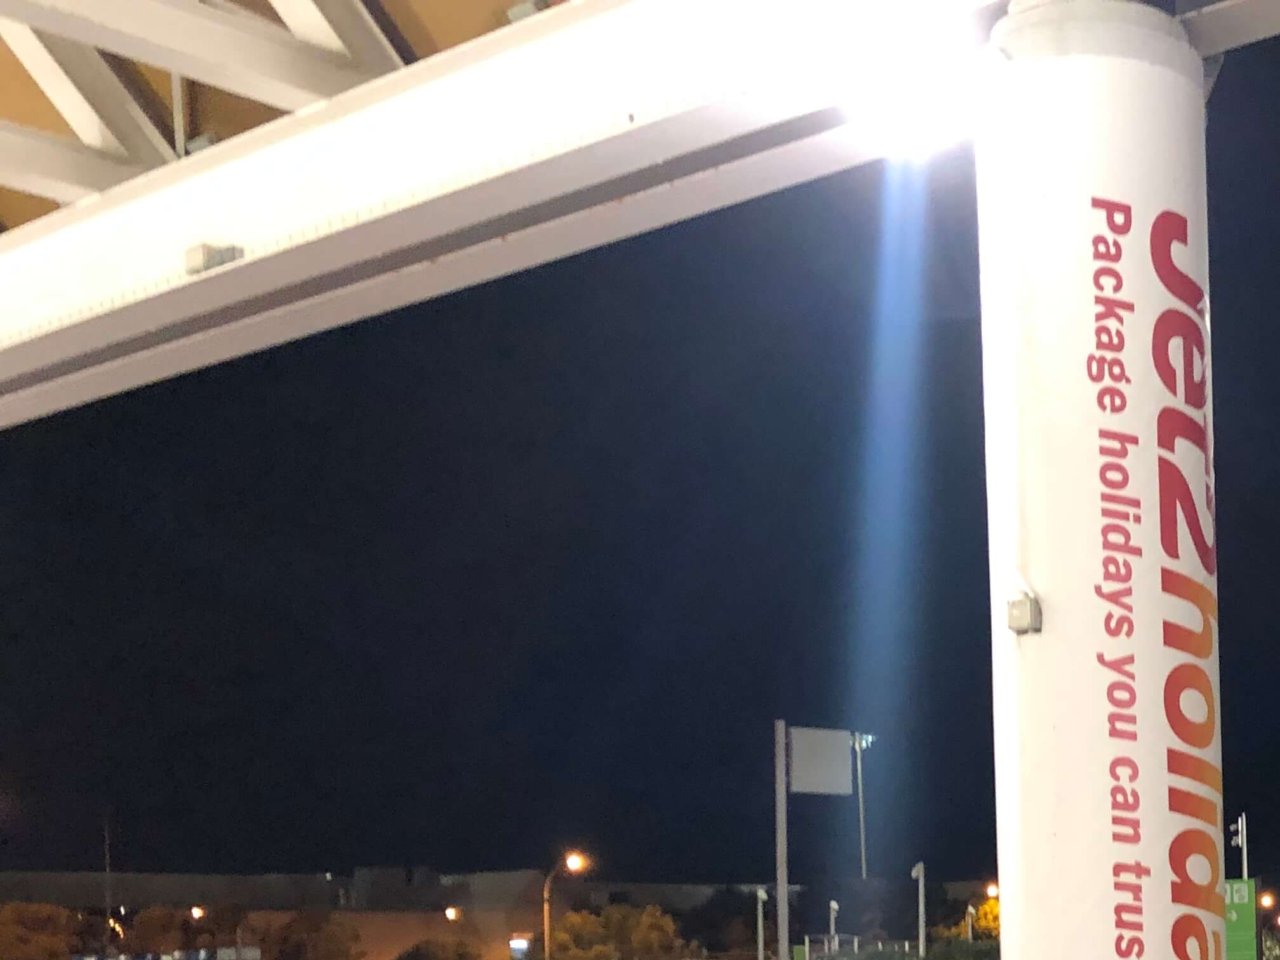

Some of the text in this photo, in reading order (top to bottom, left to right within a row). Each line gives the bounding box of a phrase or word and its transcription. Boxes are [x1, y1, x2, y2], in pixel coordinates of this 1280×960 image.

[1087, 196, 1135, 414] Package
[1094, 428, 1143, 640] holidays
[1096, 651, 1138, 742] you
[1109, 756, 1141, 846] can
